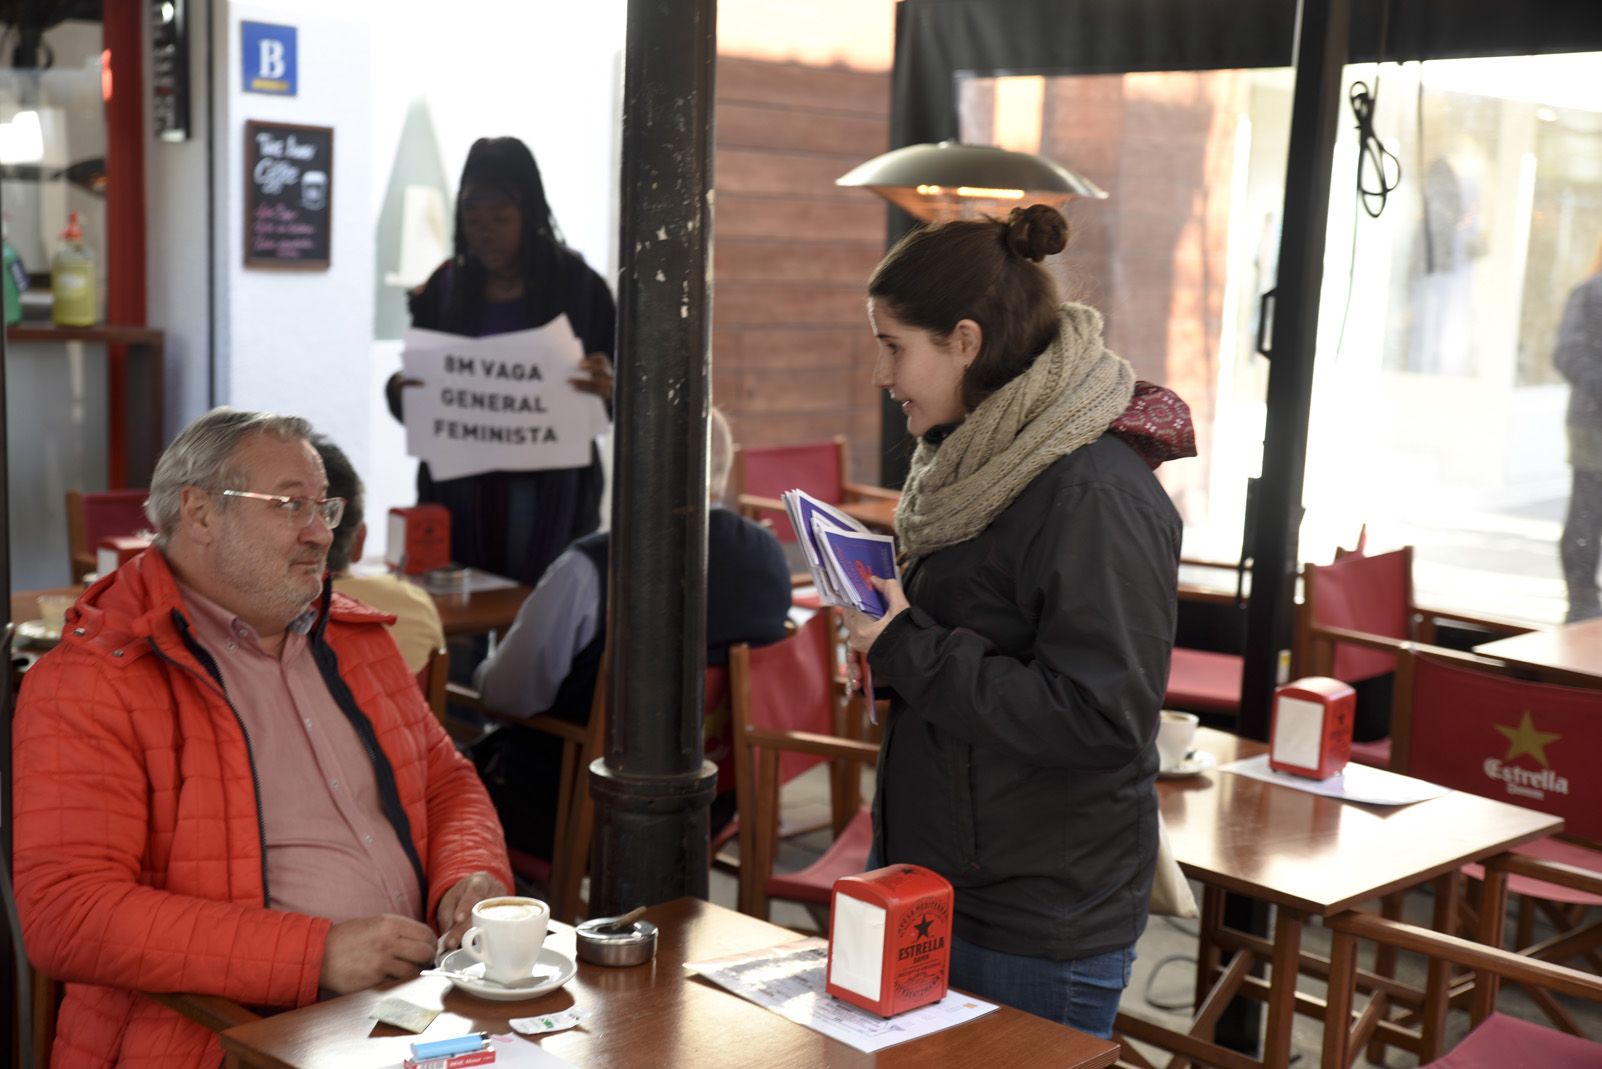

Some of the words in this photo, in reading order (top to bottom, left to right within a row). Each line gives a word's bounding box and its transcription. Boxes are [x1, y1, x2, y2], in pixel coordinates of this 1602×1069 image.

[259, 39, 286, 79] B
[444, 355, 475, 376] 8M
[481, 360, 542, 381] VAGA
[441, 388, 547, 413] GENERAL
[433, 419, 558, 444] FEMINISTA
[1483, 758, 1568, 795] Estrella
[898, 937, 945, 960] ESTRELLA
